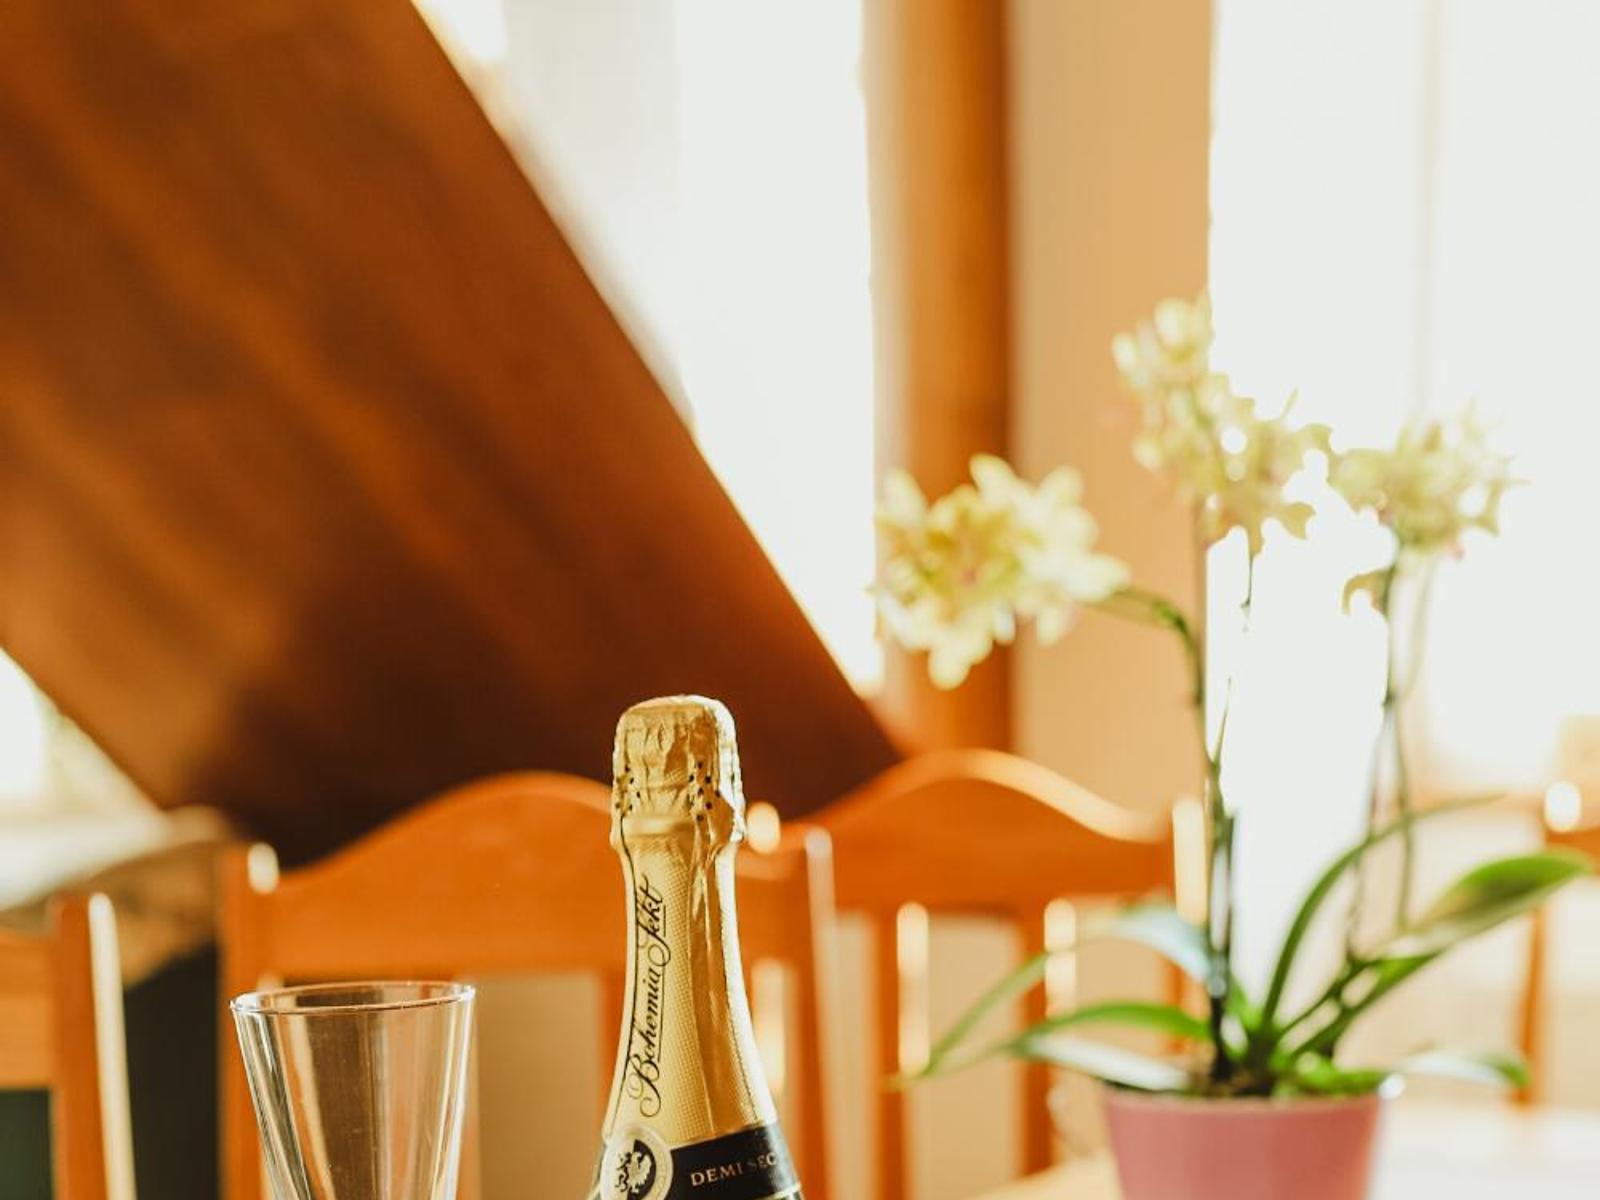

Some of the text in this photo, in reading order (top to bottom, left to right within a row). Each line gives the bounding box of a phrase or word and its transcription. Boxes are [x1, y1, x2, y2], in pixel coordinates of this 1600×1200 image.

[625, 872, 671, 1118] Bohemia Sekt
[690, 1161, 743, 1187] DEMI
